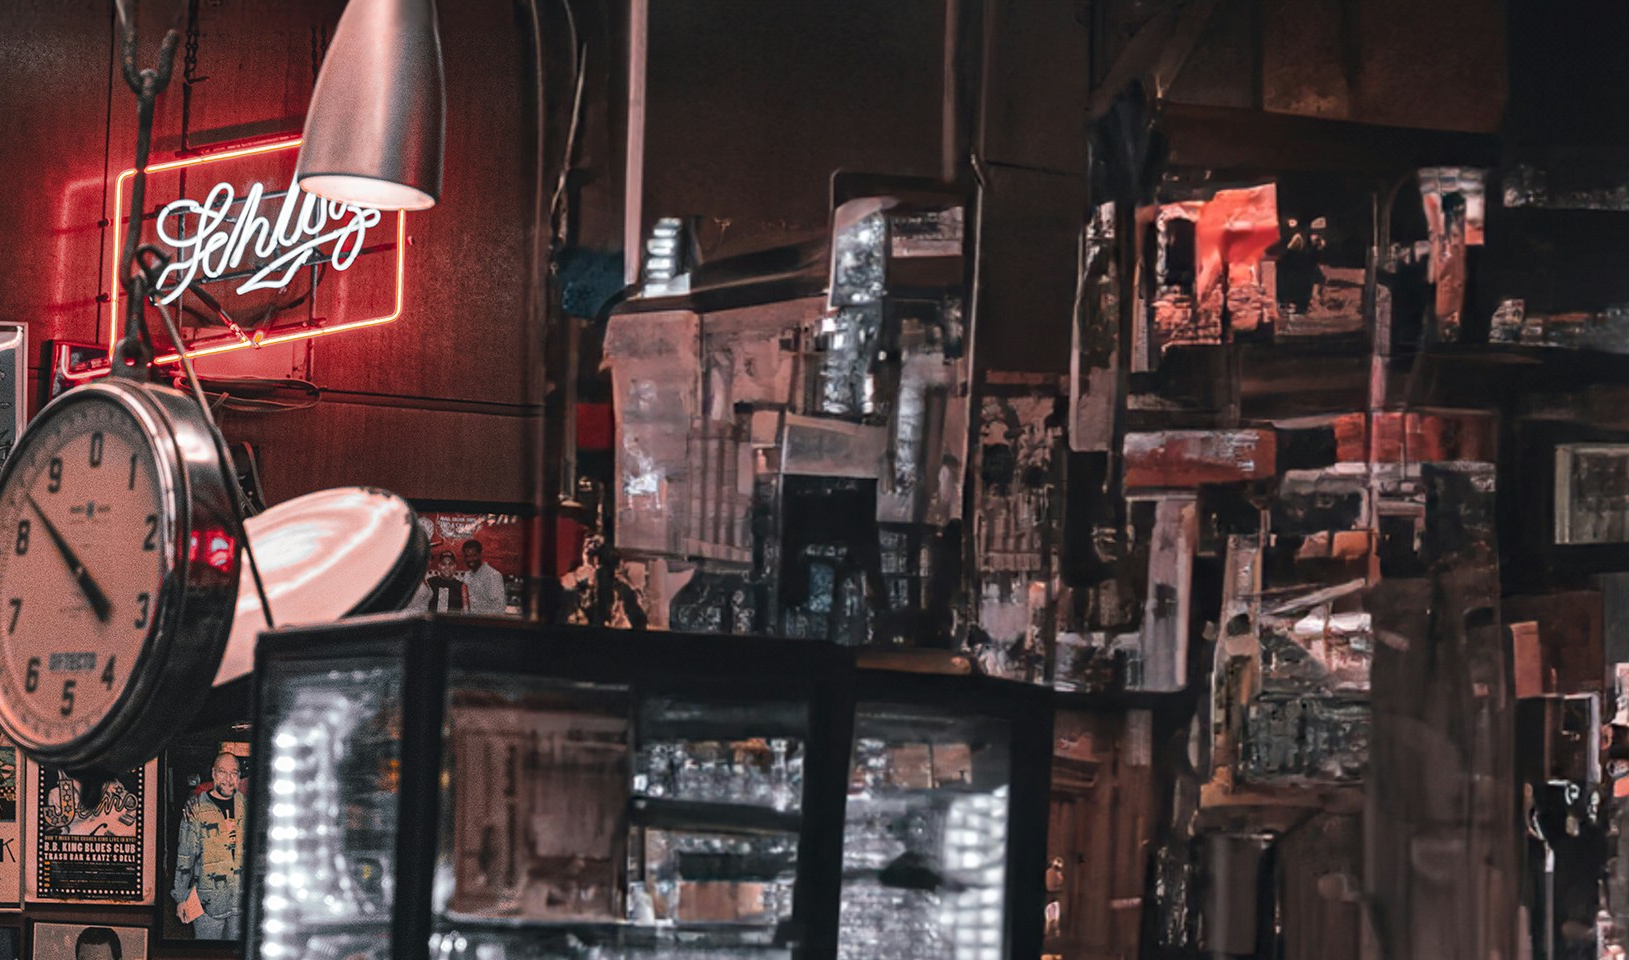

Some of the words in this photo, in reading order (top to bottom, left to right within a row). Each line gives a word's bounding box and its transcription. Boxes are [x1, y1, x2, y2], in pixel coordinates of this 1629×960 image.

[88, 431, 104, 469] 0
[47, 458, 64, 494] 9
[128, 453, 139, 491] 1
[15, 520, 32, 556] 8
[142, 514, 159, 551] 2
[6, 598, 23, 634] 7
[134, 592, 150, 630] 3
[24, 655, 42, 693] 6
[100, 655, 117, 691] 4
[59, 679, 77, 717] 5
[44, 842, 60, 852] B.B.
[62, 842, 83, 852] KING
[84, 843, 112, 853] BLUES
[113, 843, 136, 854] CLUB
[69, 853, 84, 861] BAR
